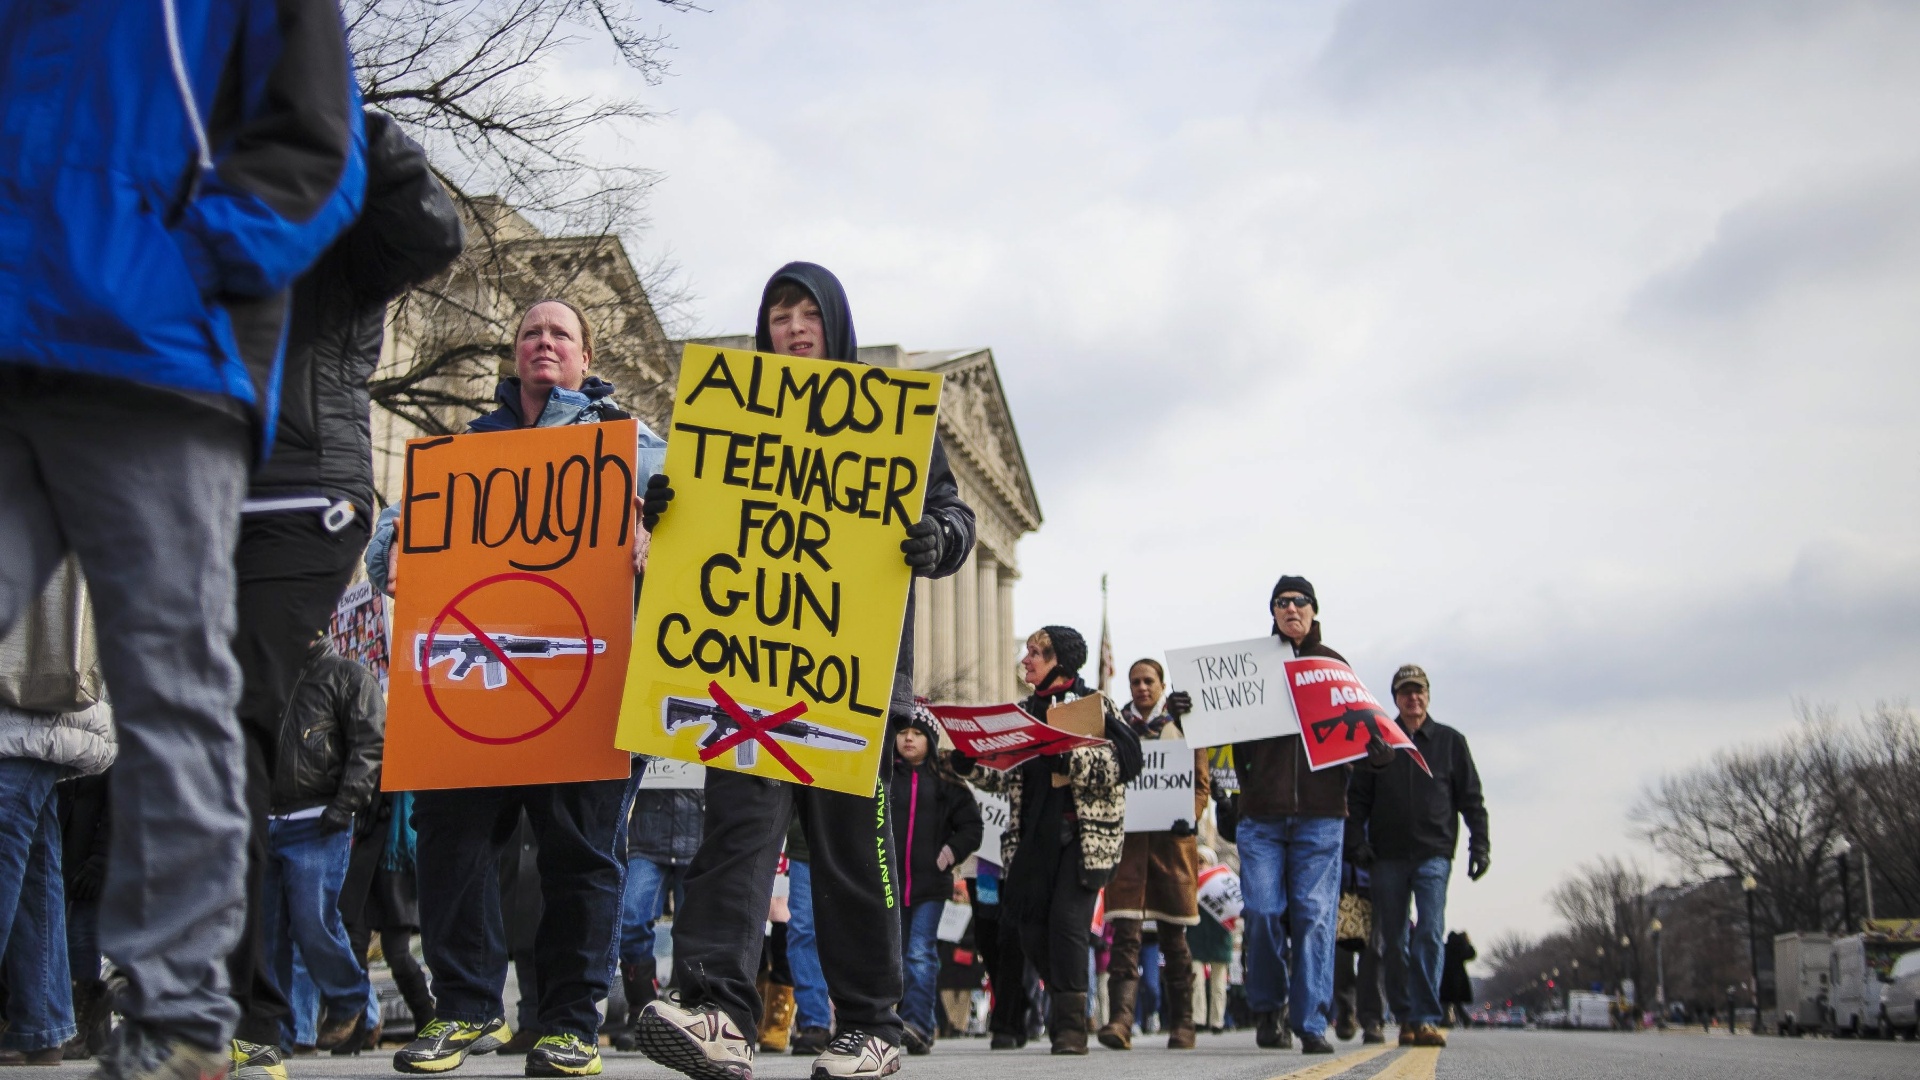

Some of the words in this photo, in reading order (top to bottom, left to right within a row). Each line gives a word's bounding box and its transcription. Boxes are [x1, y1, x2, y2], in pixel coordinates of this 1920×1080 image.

[685, 352, 938, 437] ALMOST-
[402, 427, 633, 572] Enough
[674, 422, 918, 533] TEENAGER
[737, 498, 833, 573] FOR
[699, 552, 841, 637] GUN
[656, 612, 884, 718] CONTROL
[1191, 652, 1258, 684] TRAVIS
[1201, 678, 1265, 712] NEWBY
[941, 716, 982, 732] ANOTHER
[968, 731, 1036, 753] AGAINST
[877, 836, 894, 909] GRAVITY
